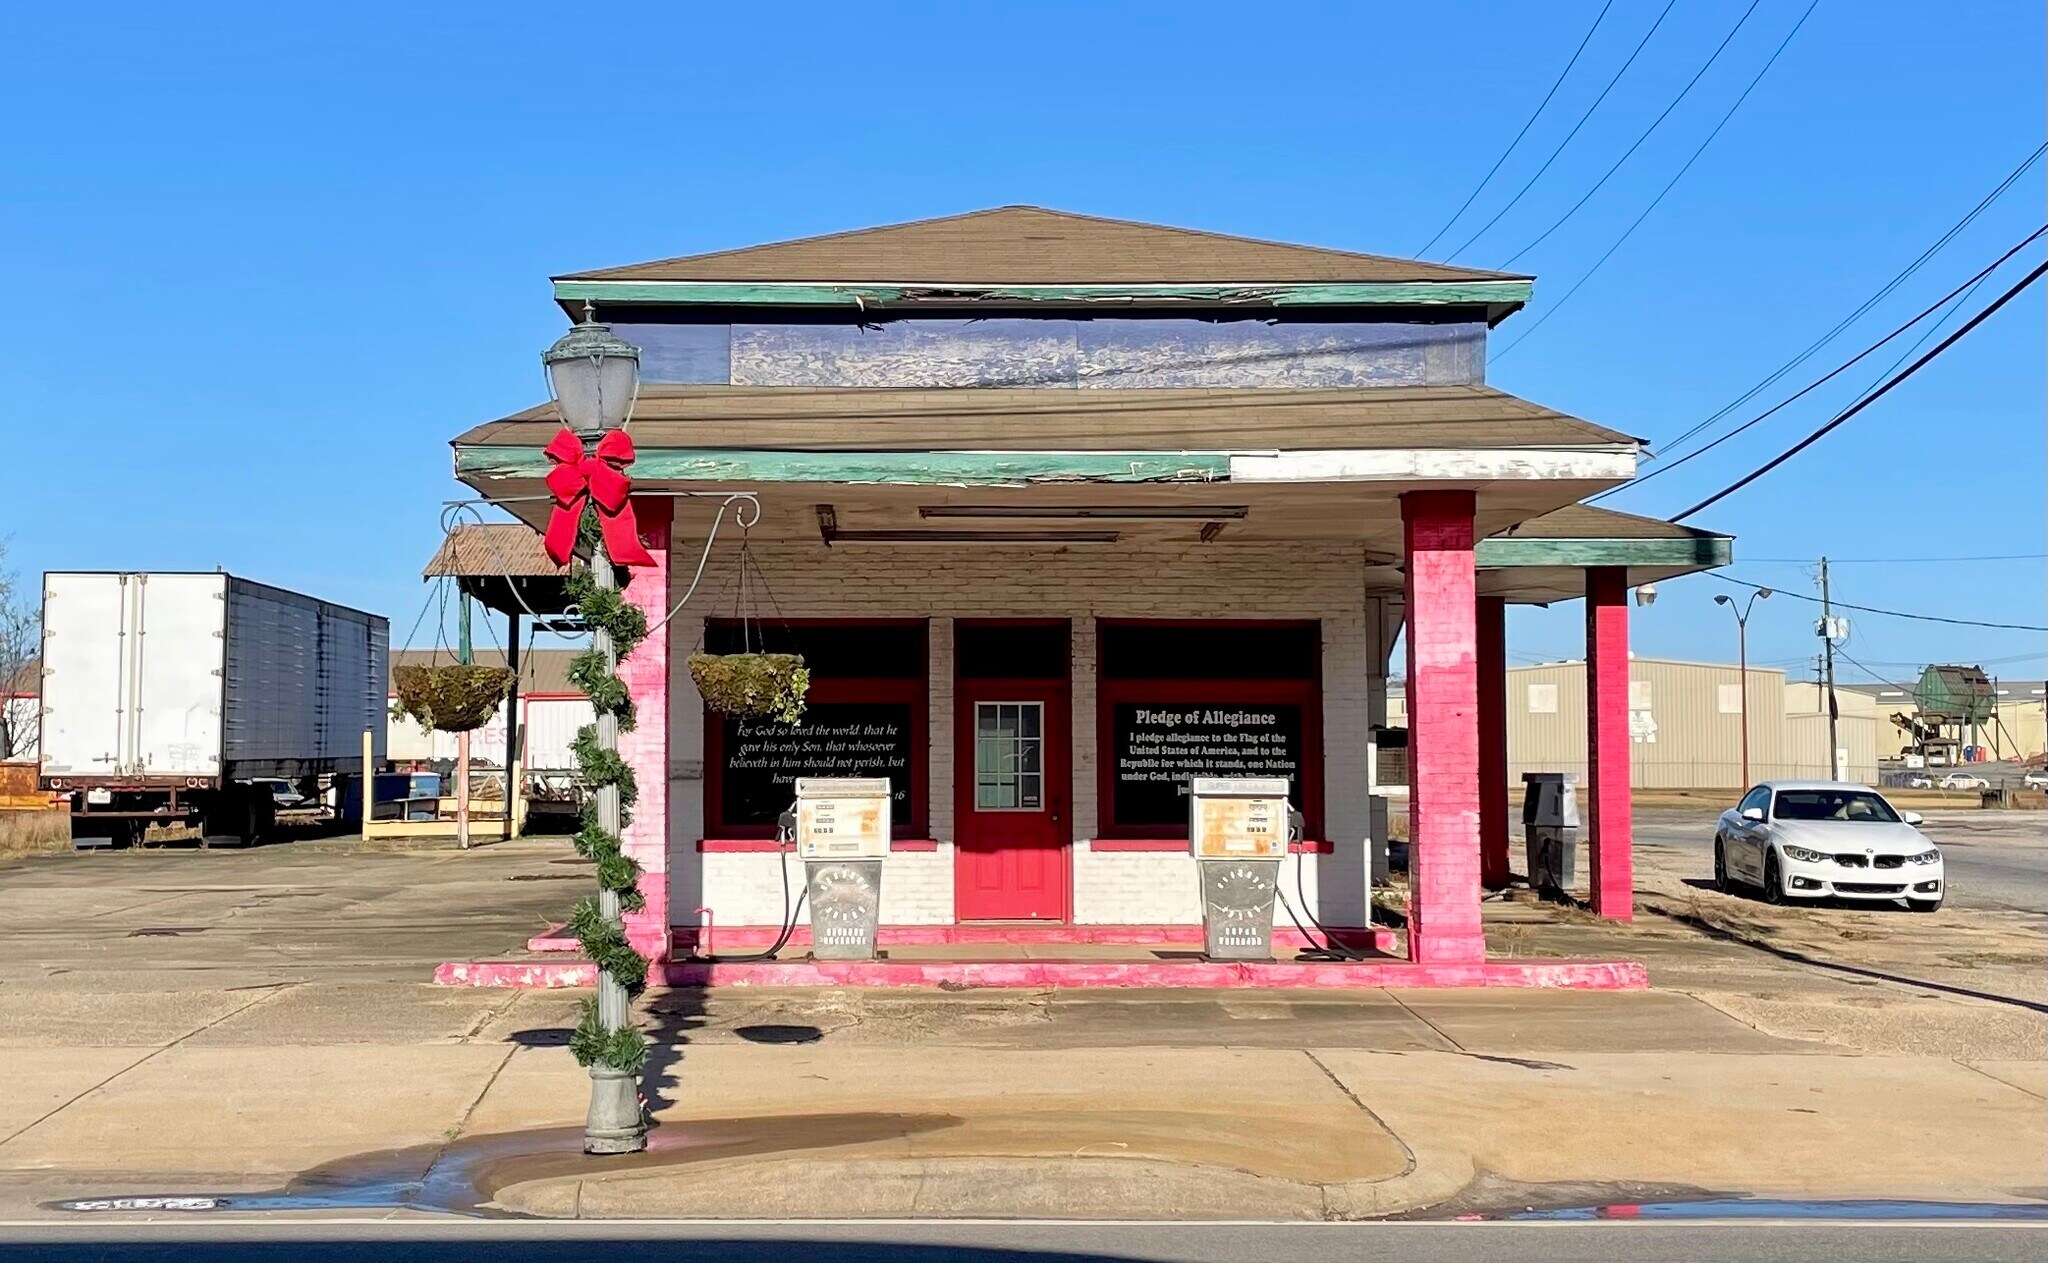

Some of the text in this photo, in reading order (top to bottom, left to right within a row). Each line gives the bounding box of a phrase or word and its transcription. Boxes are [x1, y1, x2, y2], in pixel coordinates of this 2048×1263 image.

[1136, 710, 1276, 727] Pledge of Allegiance
[737, 724, 753, 737] For
[756, 724, 776, 736] God
[777, 728, 788, 736] so
[790, 725, 814, 736] loved
[816, 724, 830, 736] the
[864, 724, 884, 736] that
[886, 724, 898, 736] he
[1130, 732, 1286, 744] I pledge allegiance to the Flag of the
[738, 744, 761, 756] gave
[763, 740, 777, 751] his
[780, 740, 800, 755] only
[826, 740, 846, 751] that
[848, 740, 896, 751] whosoever
[1130, 745, 1159, 755] United
[1162, 745, 1188, 755] States
[1190, 745, 1199, 755] of
[1241, 745, 1258, 755] and
[1260, 747, 1270, 755] to
[1272, 747, 1286, 756] the
[729, 756, 768, 768] believeth
[770, 756, 780, 768] in
[782, 756, 801, 768] him
[803, 756, 836, 768] should
[837, 758, 852, 767] not
[888, 756, 904, 768] but
[1120, 758, 1159, 769] Republic
[1161, 759, 1175, 768] for
[1177, 759, 1204, 768] which
[1206, 759, 1213, 768] it
[1265, 760, 1295, 768] Nation
[772, 772, 794, 784] have
[1121, 772, 1148, 780] under
